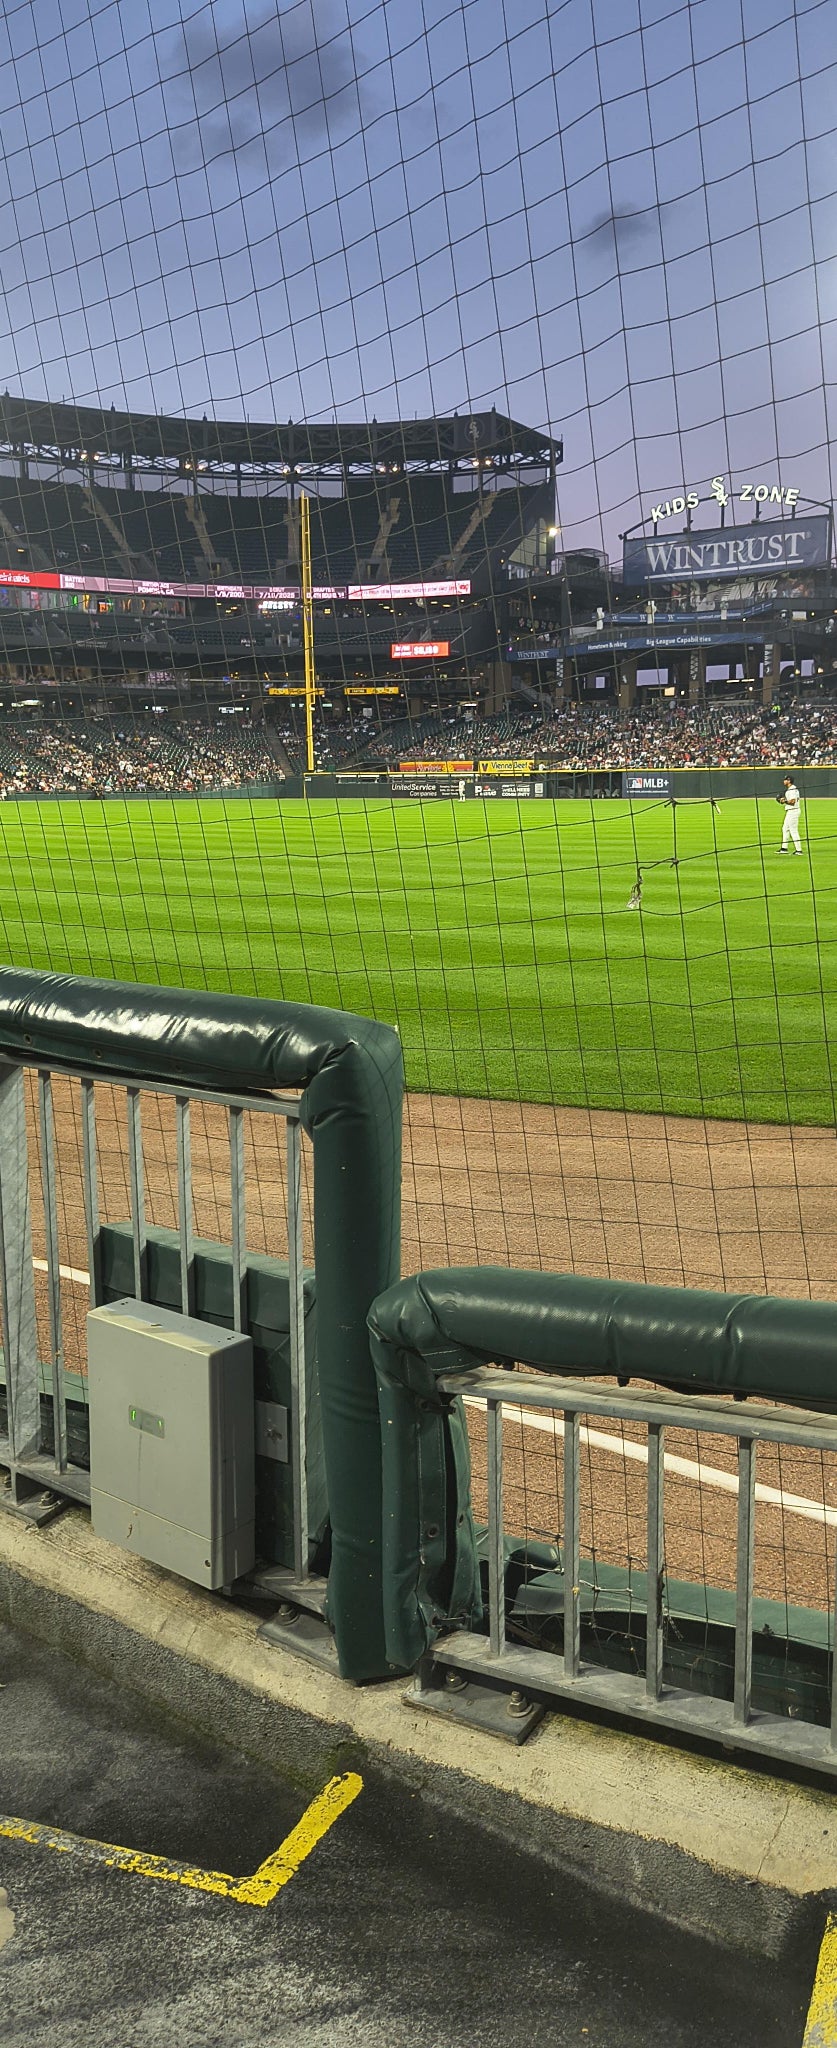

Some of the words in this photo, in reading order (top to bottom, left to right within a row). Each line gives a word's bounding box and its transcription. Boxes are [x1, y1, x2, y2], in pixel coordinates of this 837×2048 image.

[651, 493, 699, 523] KIDS
[739, 485, 800, 506] ZONE
[646, 531, 806, 572] WINTRUST
[491, 761, 513, 770] Vienna
[643, 778, 670, 788] MLB+
